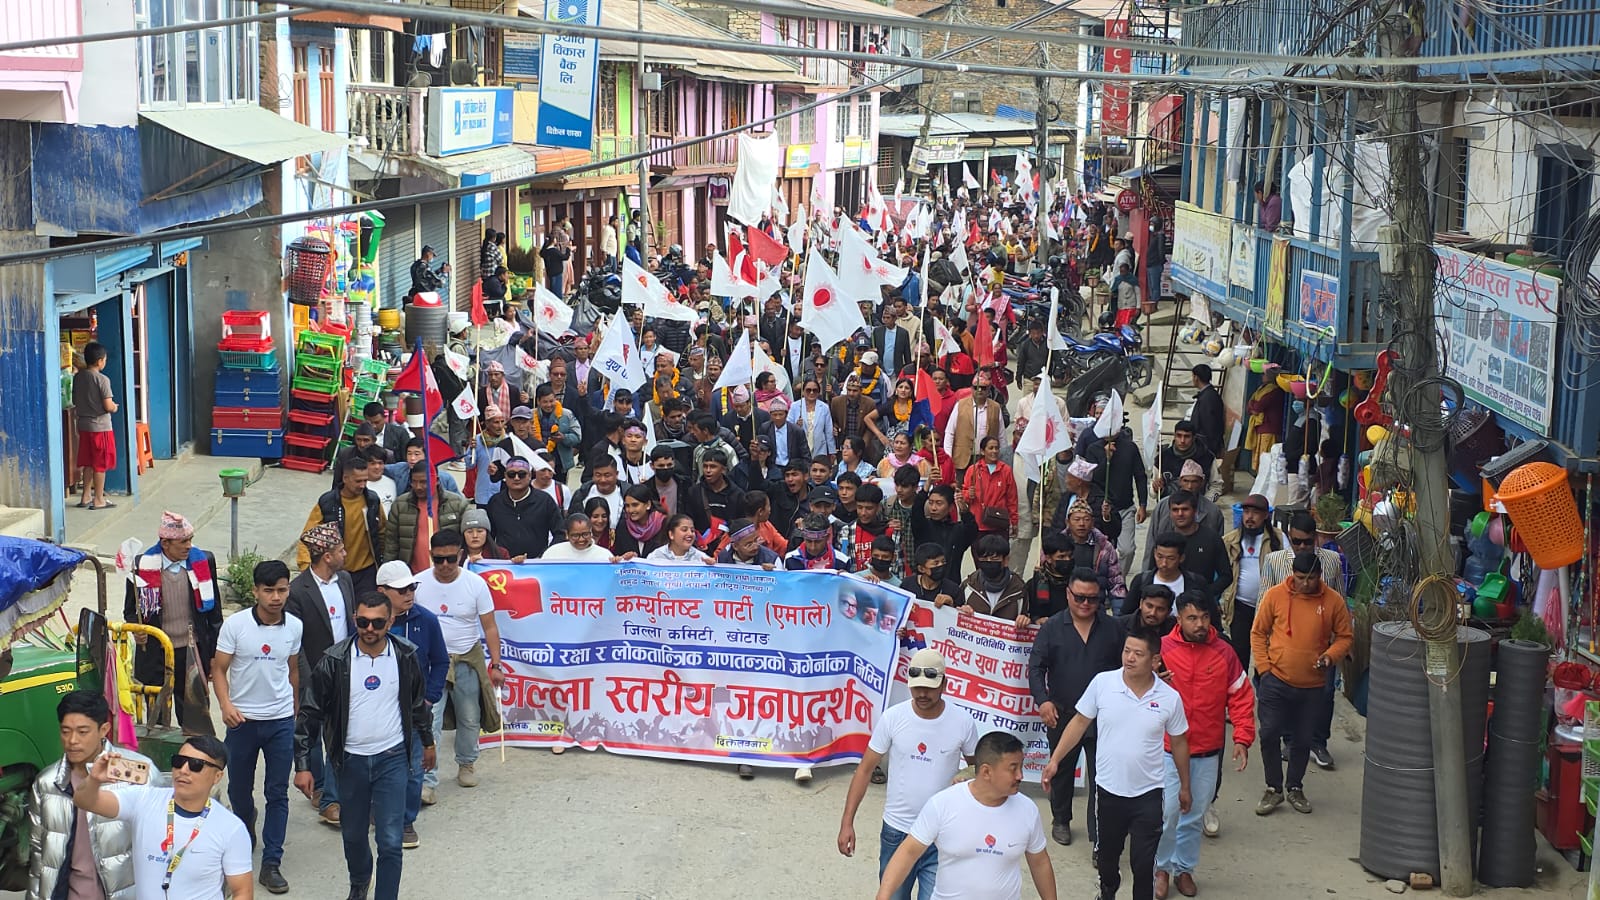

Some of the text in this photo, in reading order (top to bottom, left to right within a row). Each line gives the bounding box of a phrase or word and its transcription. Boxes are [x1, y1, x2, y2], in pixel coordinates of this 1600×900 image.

[553, 43, 586, 58] विकास
[1119, 196, 1136, 204] ATM
[1515, 277, 1553, 314] स्टोर
[549, 591, 831, 630] नेपाल कम्युनिष्ट पार्टी (एमाले)
[623, 621, 662, 640] जिल्ला
[975, 636, 1006, 651] प्रतिनिधि
[559, 648, 590, 665] रक्षा
[594, 647, 606, 662] र
[611, 641, 702, 667] लोकतान्त्रिक
[707, 651, 786, 672] गणतन्त्रको
[789, 654, 850, 675] जगेर्नाका
[853, 655, 884, 691] निम्ति
[975, 653, 999, 675] युवा
[1002, 658, 1023, 680] संघ
[56, 683, 74, 694] 5310
[605, 669, 716, 718] स्तरीय
[726, 678, 874, 731] जनप्रदर्शन
[976, 682, 1040, 716] जनप्र
[992, 714, 1030, 732] सफल
